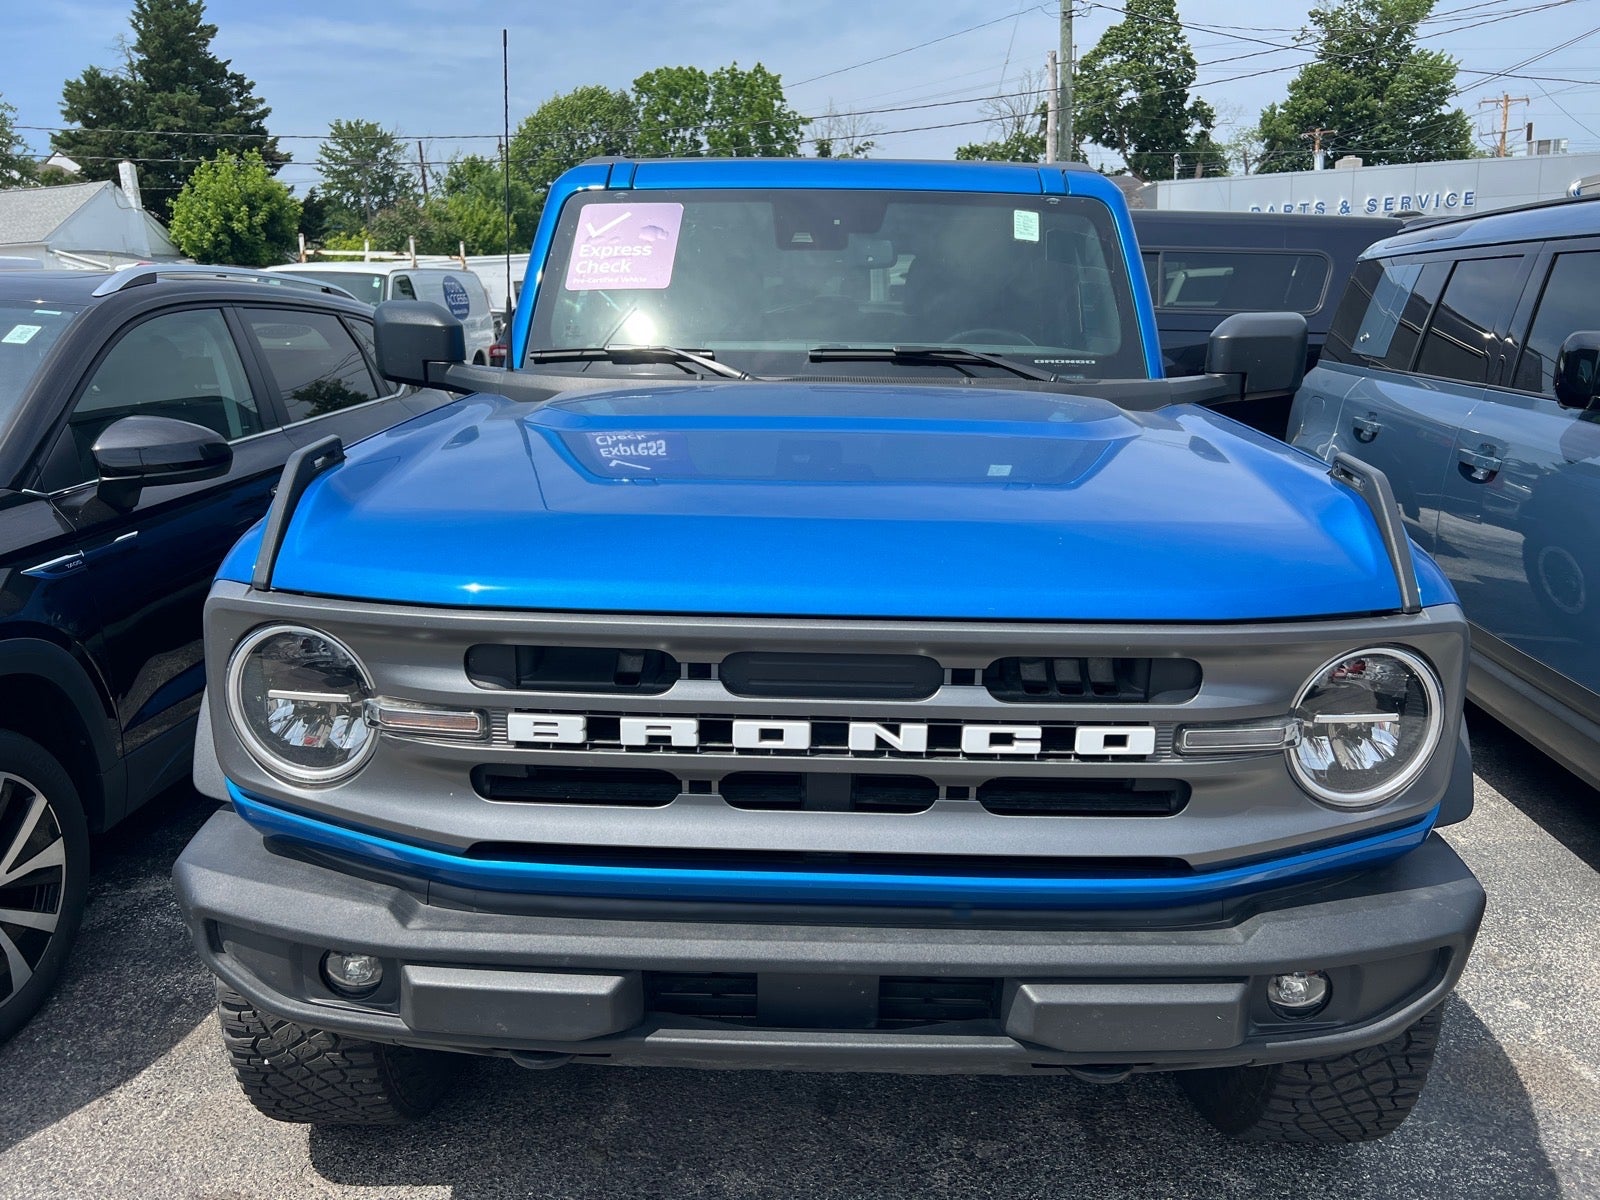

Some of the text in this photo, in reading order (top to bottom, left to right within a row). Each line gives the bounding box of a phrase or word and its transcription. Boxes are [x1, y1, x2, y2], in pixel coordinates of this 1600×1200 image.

[1340, 200, 1350, 214] &
[1366, 191, 1475, 213] SERVICE
[580, 244, 653, 259] Express
[575, 259, 632, 273] Check
[507, 713, 1155, 755] BRONCO
